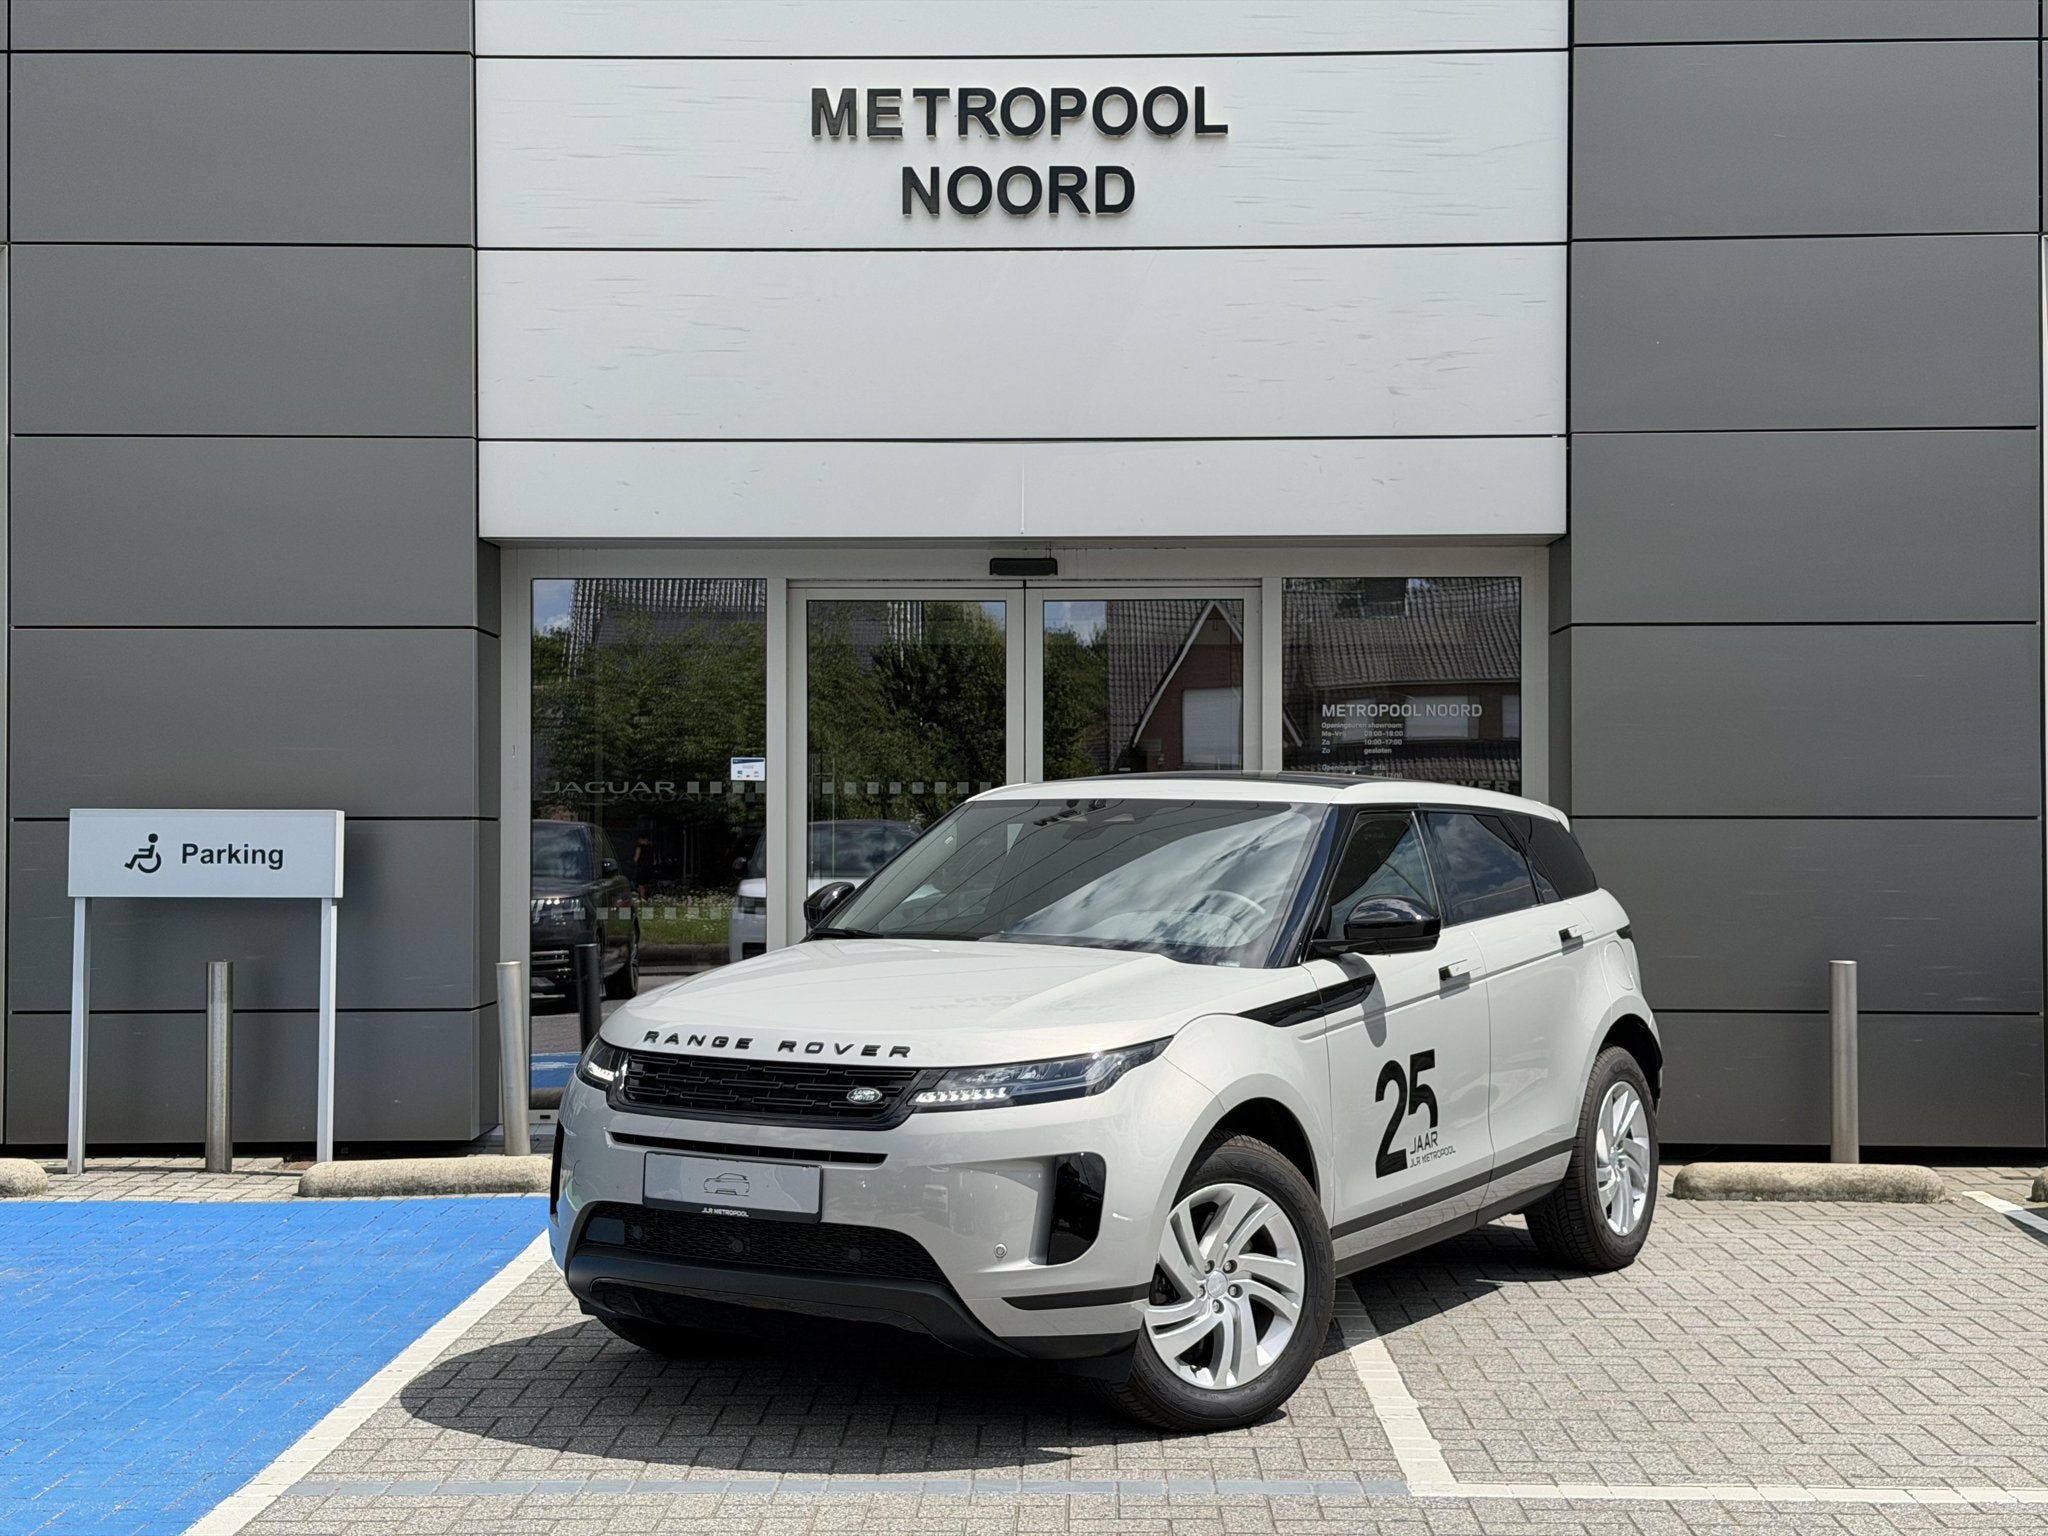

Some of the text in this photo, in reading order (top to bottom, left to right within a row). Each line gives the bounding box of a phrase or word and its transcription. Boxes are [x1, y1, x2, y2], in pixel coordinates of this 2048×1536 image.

[811, 86, 1228, 138] METROPOOL
[902, 165, 1135, 216] NOORD
[1321, 703, 1482, 717] METROPOOL NOORD
[541, 780, 676, 795] JAGUAR
[181, 842, 284, 871] Parking
[643, 1030, 912, 1058] RANGE ROVER
[1375, 1048, 1438, 1179] 25
[1409, 1131, 1438, 1154] JAAR
[1409, 1145, 1456, 1168] JLR METROPOOL
[713, 1208, 750, 1218] METROPOOL
